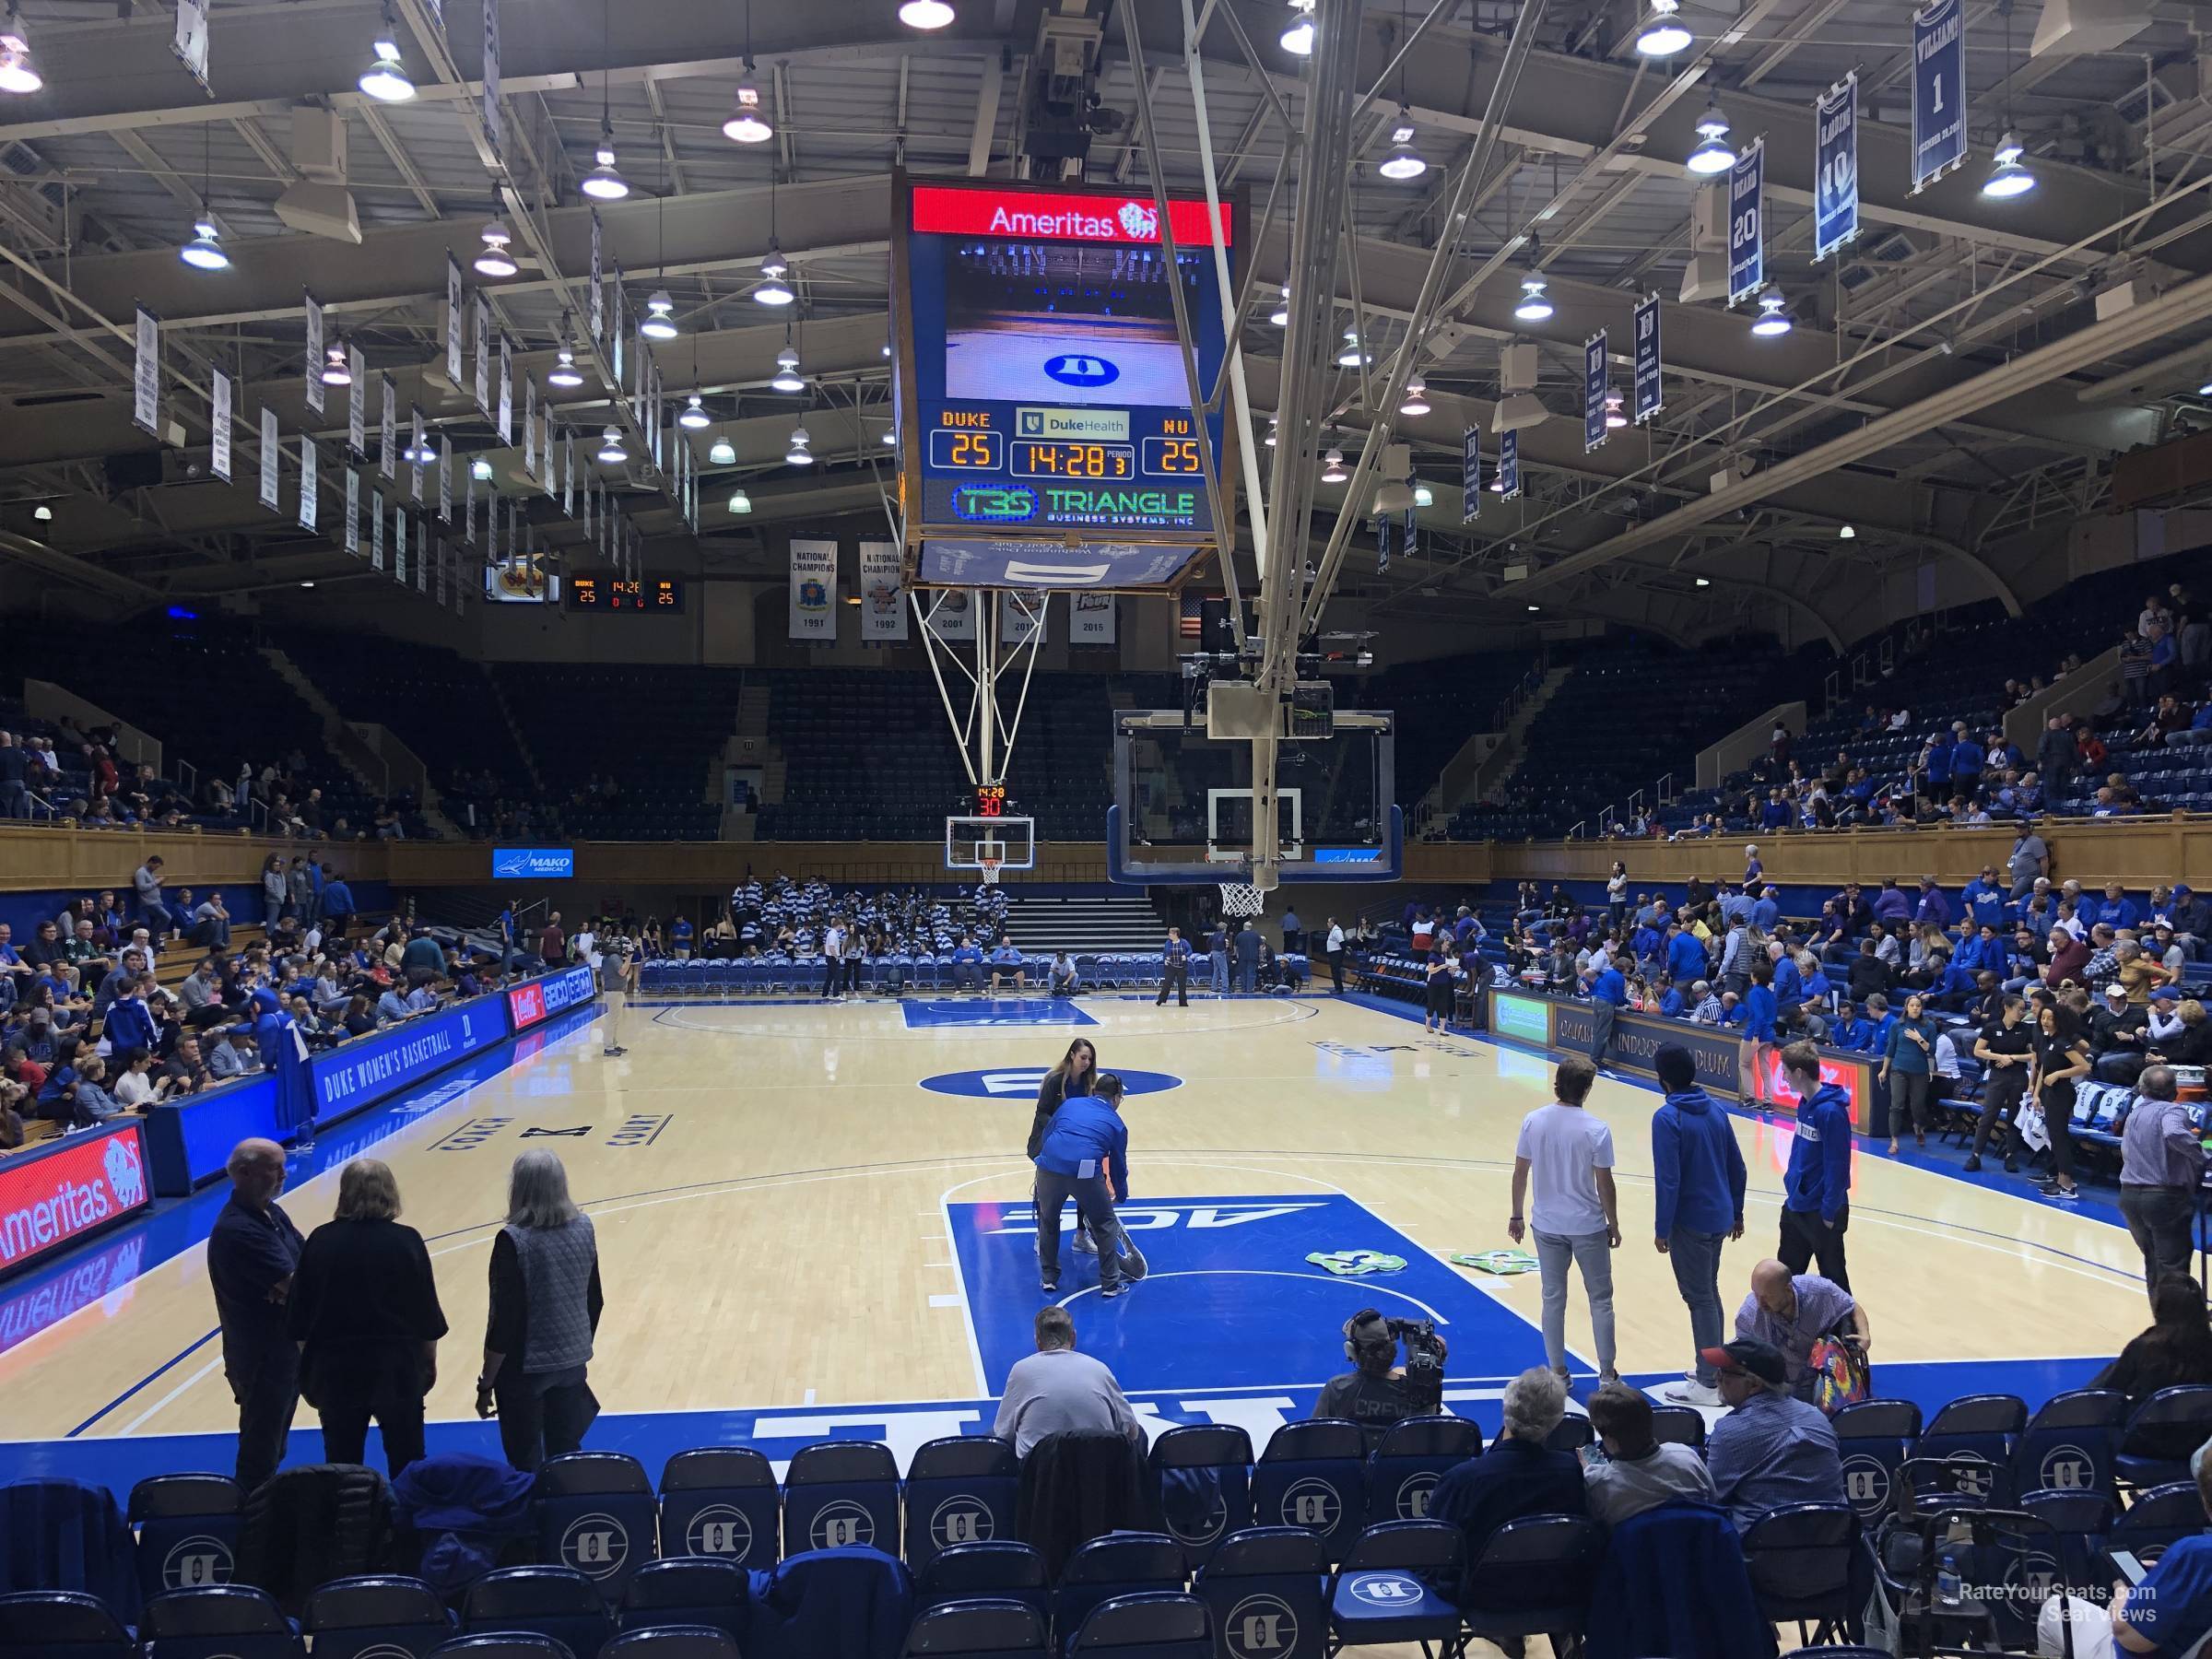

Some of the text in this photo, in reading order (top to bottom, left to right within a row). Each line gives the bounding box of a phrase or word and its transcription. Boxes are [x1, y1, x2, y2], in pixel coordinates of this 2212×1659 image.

[1933, 73, 1944, 114] 1
[1822, 151, 1852, 196] 10
[990, 206, 1112, 237] Ameritas
[1733, 207, 1757, 250] 20
[943, 411, 991, 429] DUKE
[1050, 418, 1124, 432] DukeHealth
[1164, 419, 1188, 434] NU
[951, 434, 990, 465] 25
[1107, 450, 1132, 459] PERIOD
[1161, 441, 1199, 471] 25
[1029, 445, 1104, 477] 14:28
[1115, 458, 1125, 475] 3
[1046, 489, 1194, 514] TRIANGLE
[1047, 513, 1107, 523] BUSINESS
[1174, 516, 1194, 524] INC
[796, 552, 831, 562] NATIONAL
[793, 562, 835, 572] CHAMPIONS
[863, 565, 900, 574] CHAMPION
[580, 591, 595, 603] 25
[658, 593, 674, 605] 25
[804, 618, 825, 628] 1991
[876, 620, 896, 629] 1992
[942, 619, 963, 629] 2001
[1083, 623, 1104, 631] 2015
[978, 787, 1005, 798] 14:28
[980, 797, 1001, 816] 30
[529, 857, 570, 867] MAKO
[543, 980, 570, 1010] GEICO
[324, 1067, 356, 1103] DUKE
[357, 1050, 401, 1088] WOMEN'S
[401, 1030, 452, 1070] BASKETBALL
[1694, 1049, 1731, 1077] DIUM
[1355, 1399, 1412, 1417] CREW
